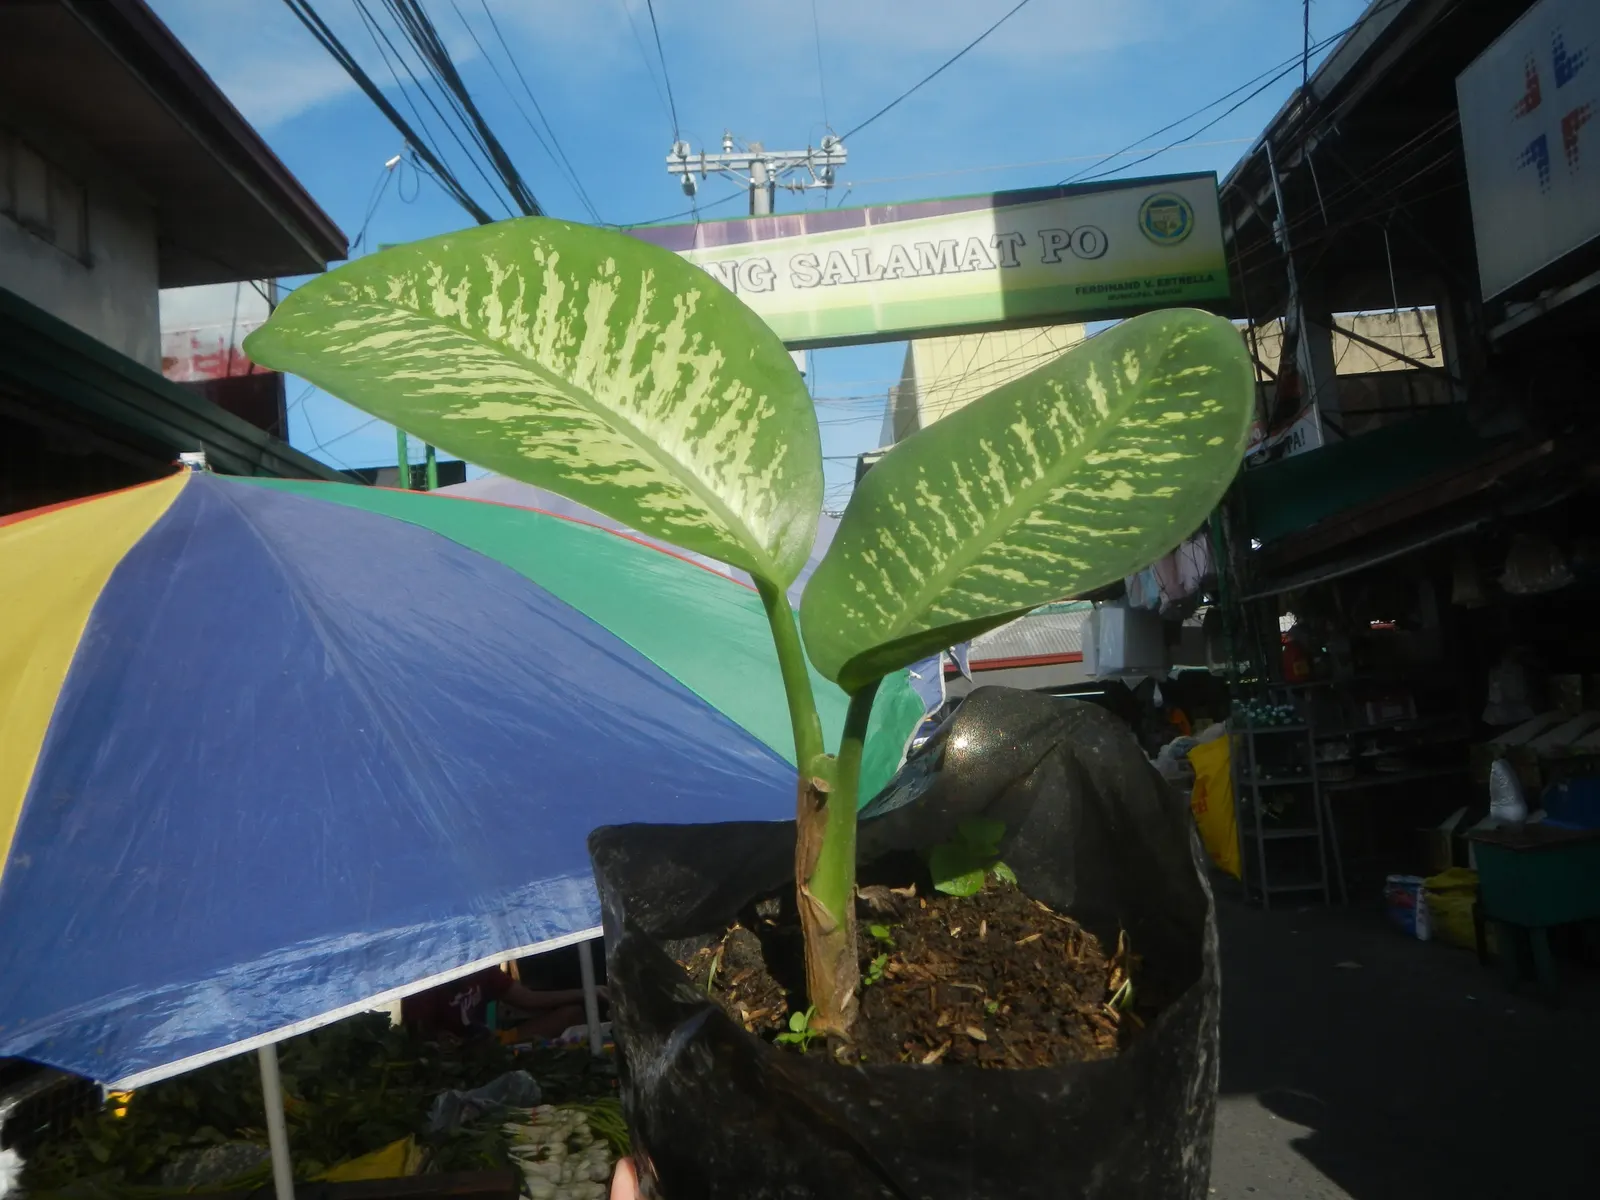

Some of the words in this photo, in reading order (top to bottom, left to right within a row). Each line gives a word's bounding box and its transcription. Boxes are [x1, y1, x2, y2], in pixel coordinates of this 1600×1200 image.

[790, 232, 1026, 287] SALAMAT
[1038, 225, 1108, 264] PO
[1075, 280, 1141, 295] FERDINAND
[1157, 273, 1215, 287] ESTRELLA
